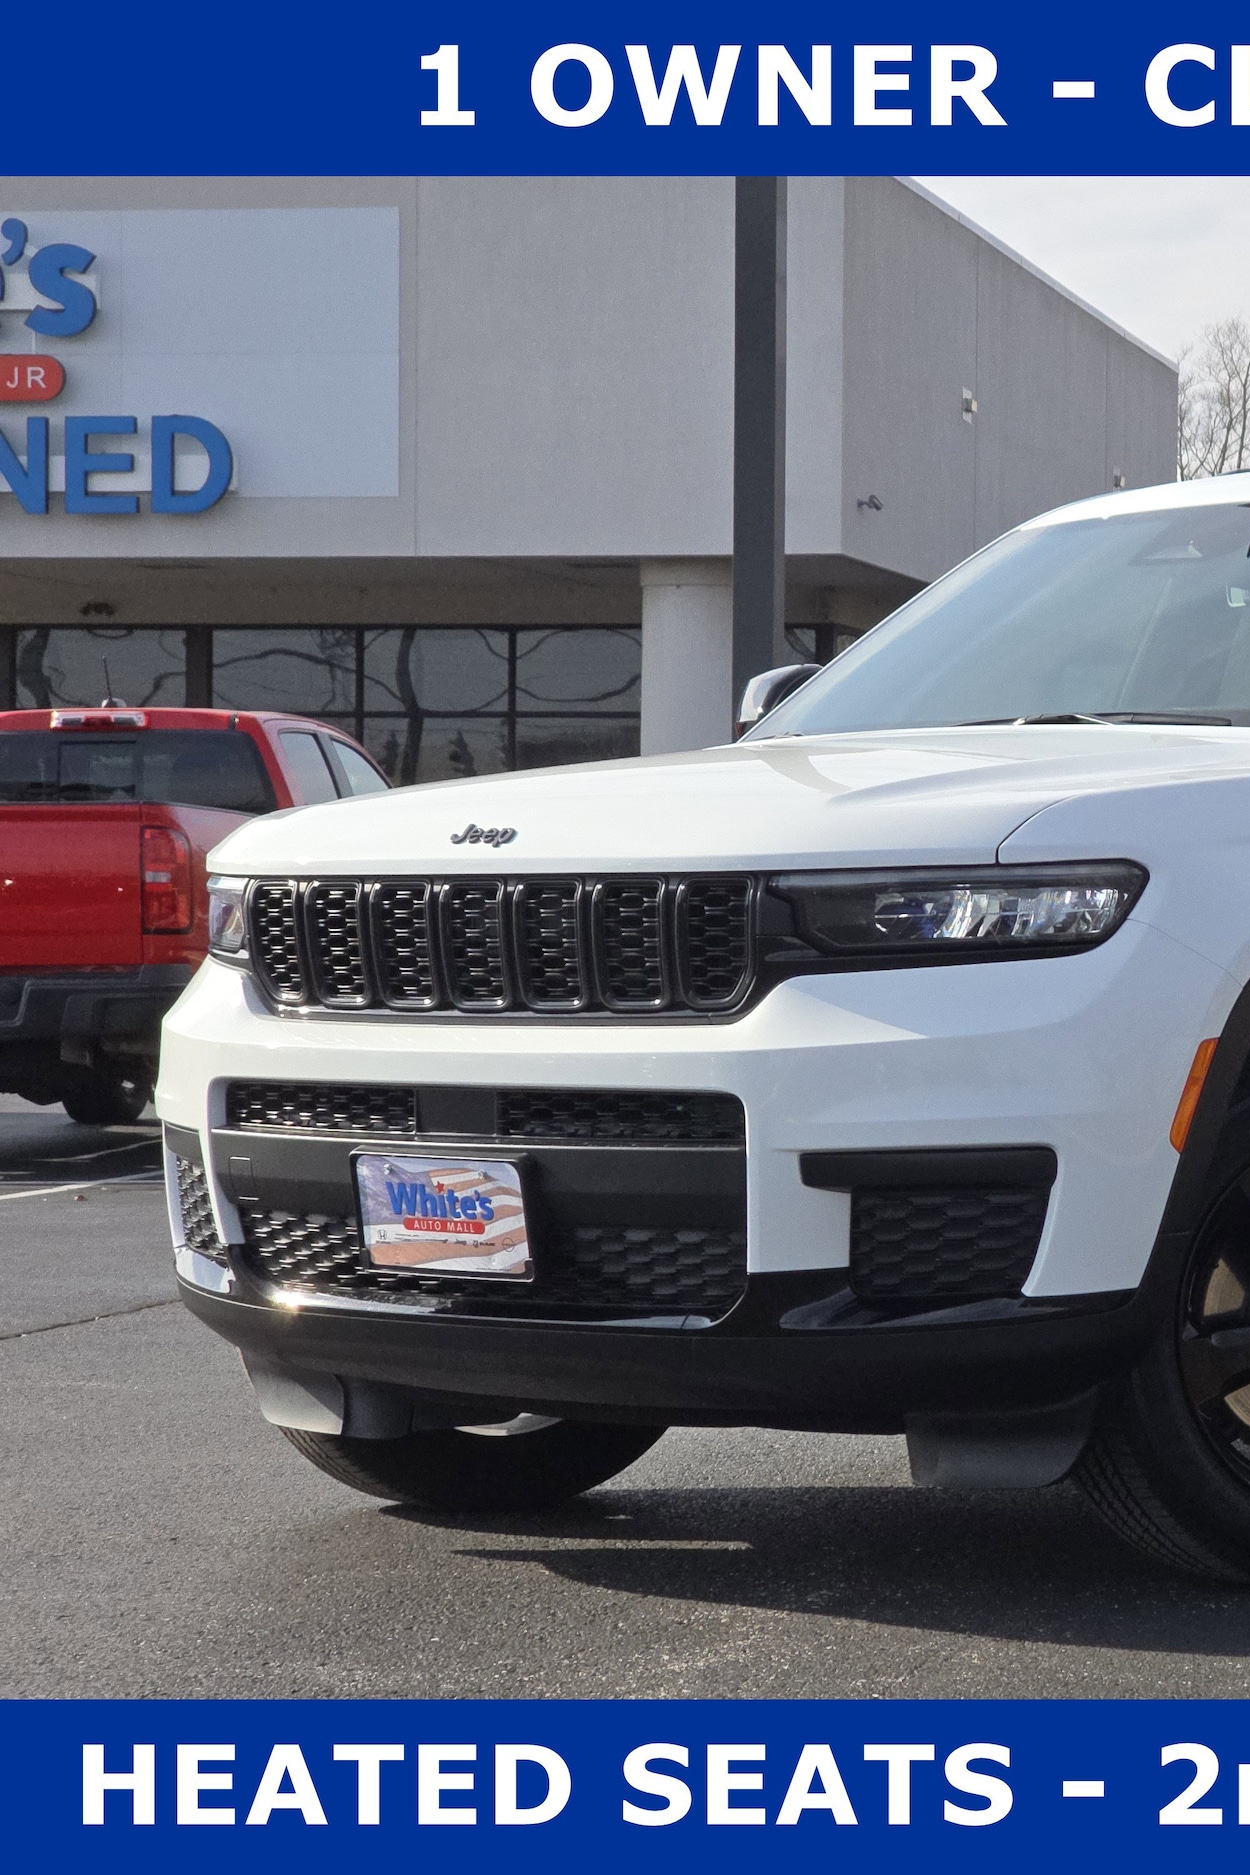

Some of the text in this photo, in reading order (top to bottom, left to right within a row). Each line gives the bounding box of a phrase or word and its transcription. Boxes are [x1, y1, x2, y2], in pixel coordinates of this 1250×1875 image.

[0, 217, 97, 337] 's
[450, 823, 518, 848] Jeep
[385, 1180, 495, 1222] White's
[413, 1219, 476, 1234] AUTO MALL
